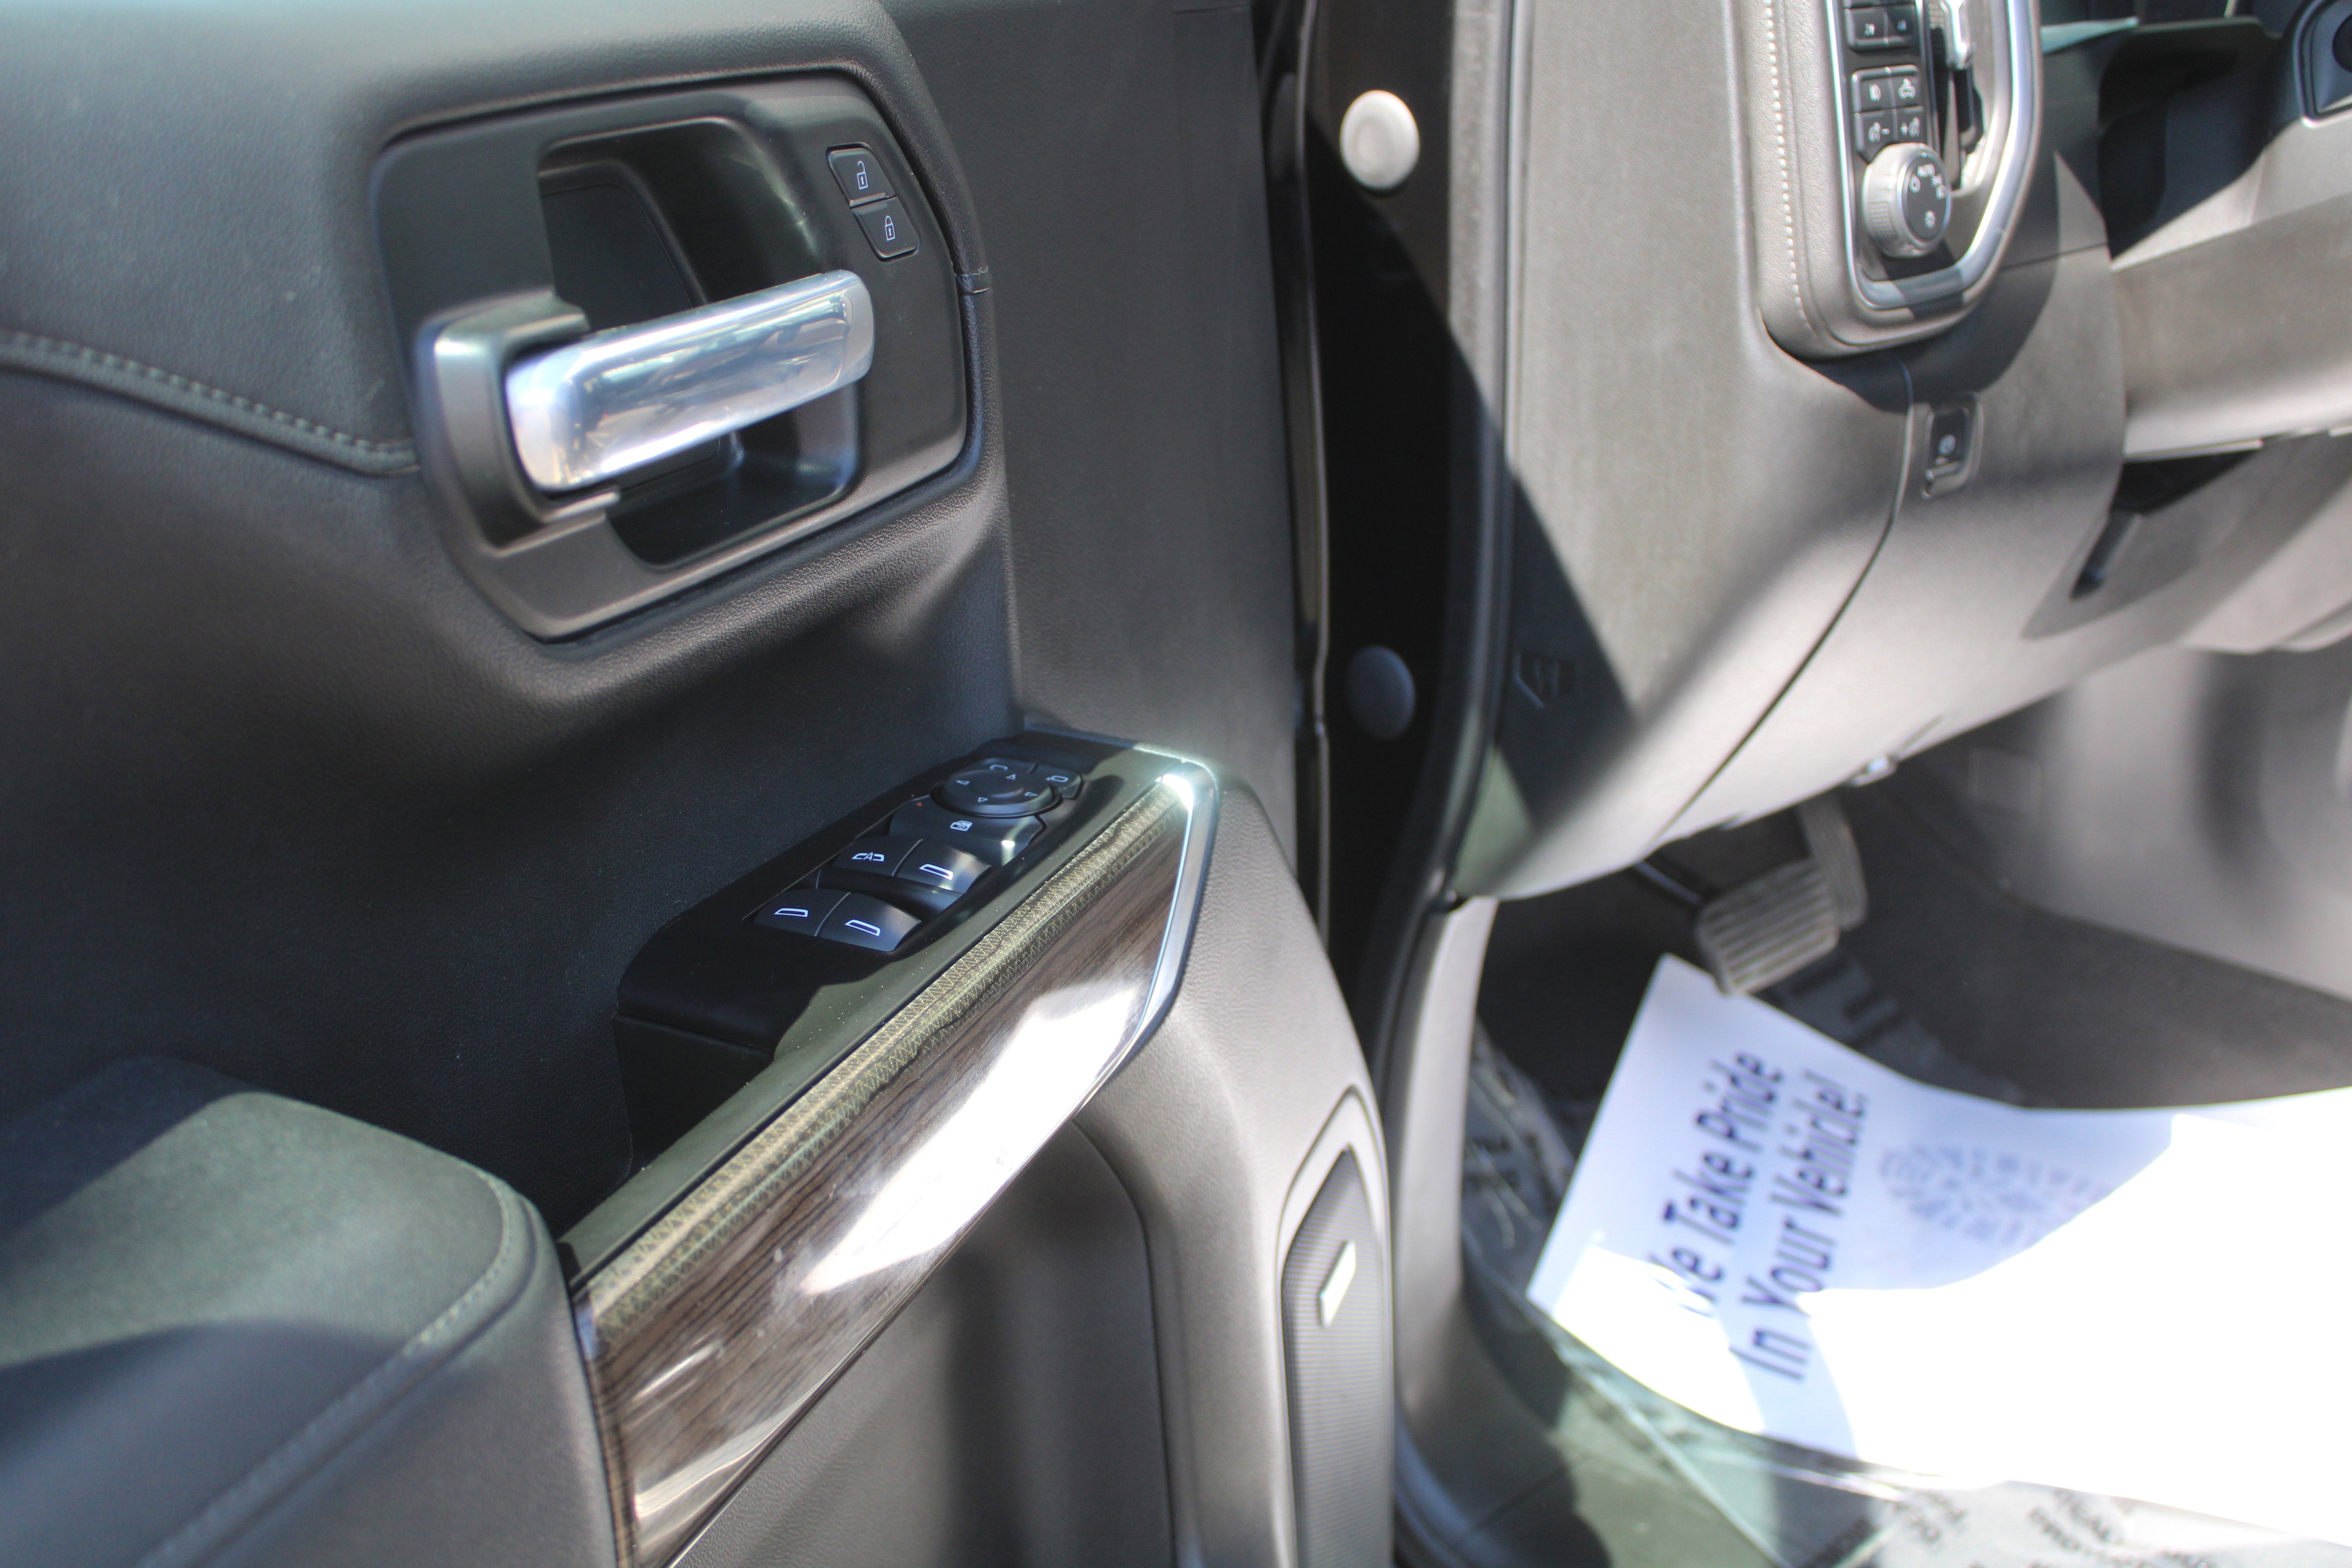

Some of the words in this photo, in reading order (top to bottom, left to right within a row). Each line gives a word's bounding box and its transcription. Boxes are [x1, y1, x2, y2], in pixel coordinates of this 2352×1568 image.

[1693, 1052, 1783, 1152] Pride
[1767, 1069, 1867, 1217] Vehicle!
[1663, 1151, 1755, 1245] Take
[1740, 1216, 1838, 1318] Your
[1728, 1328, 1813, 1379] In
